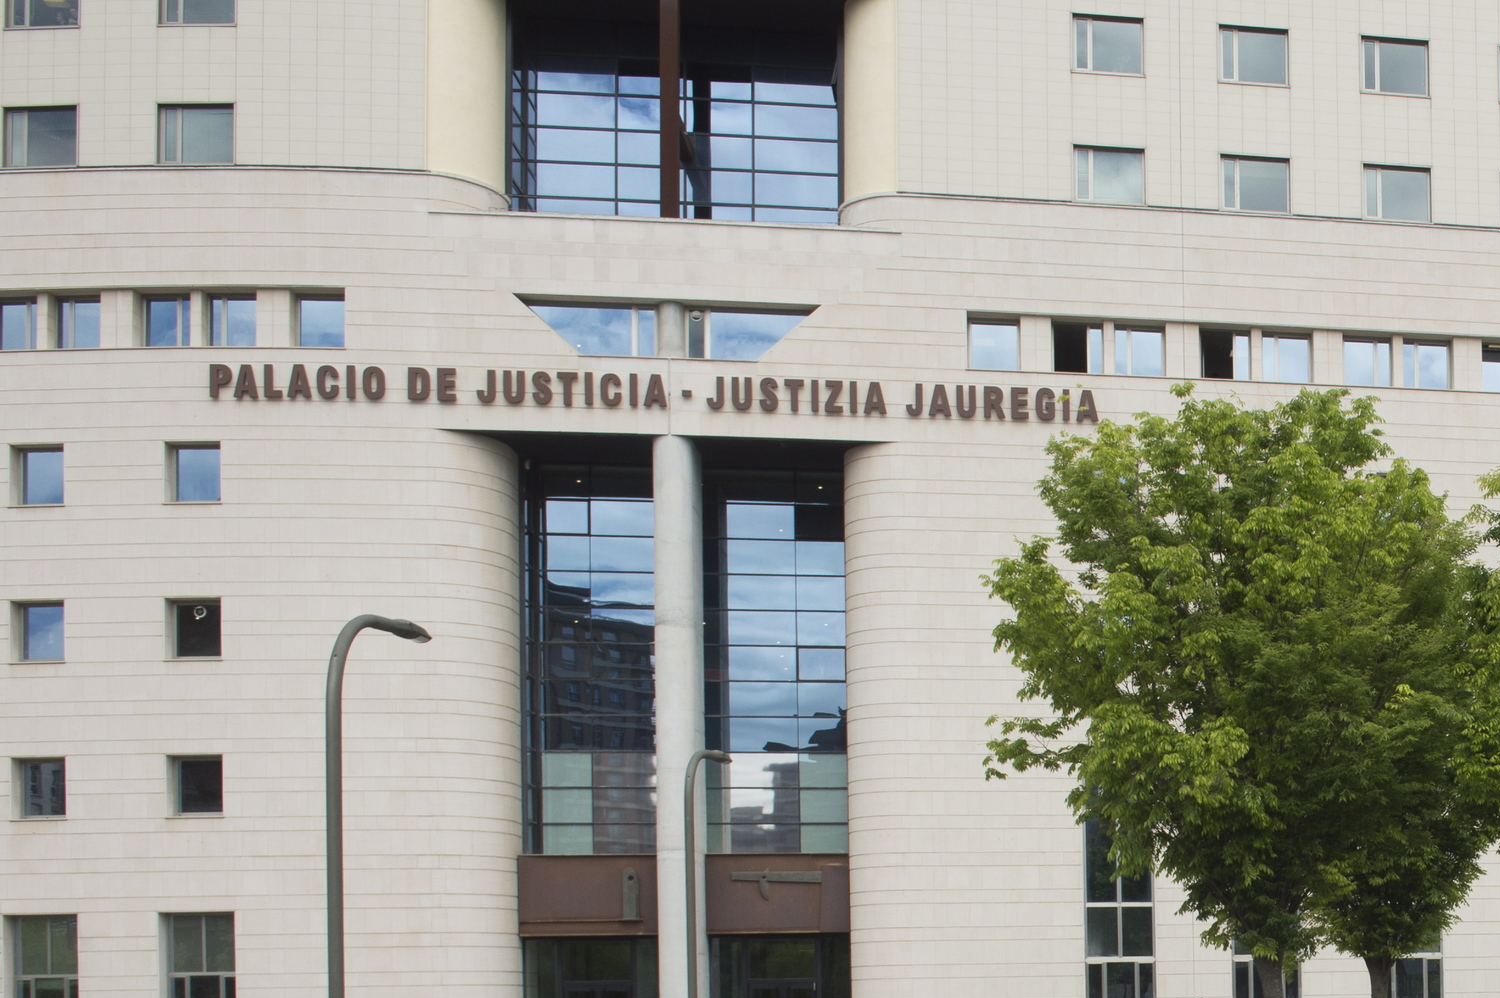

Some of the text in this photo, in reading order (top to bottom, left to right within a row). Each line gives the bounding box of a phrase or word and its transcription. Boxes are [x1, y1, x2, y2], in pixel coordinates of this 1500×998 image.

[209, 363, 387, 400] PALACIO
[407, 366, 458, 402] DE
[476, 369, 668, 408] JUSTICIA
[706, 376, 888, 415] JUSTIZIA
[905, 383, 1099, 422] JAUREGIA
